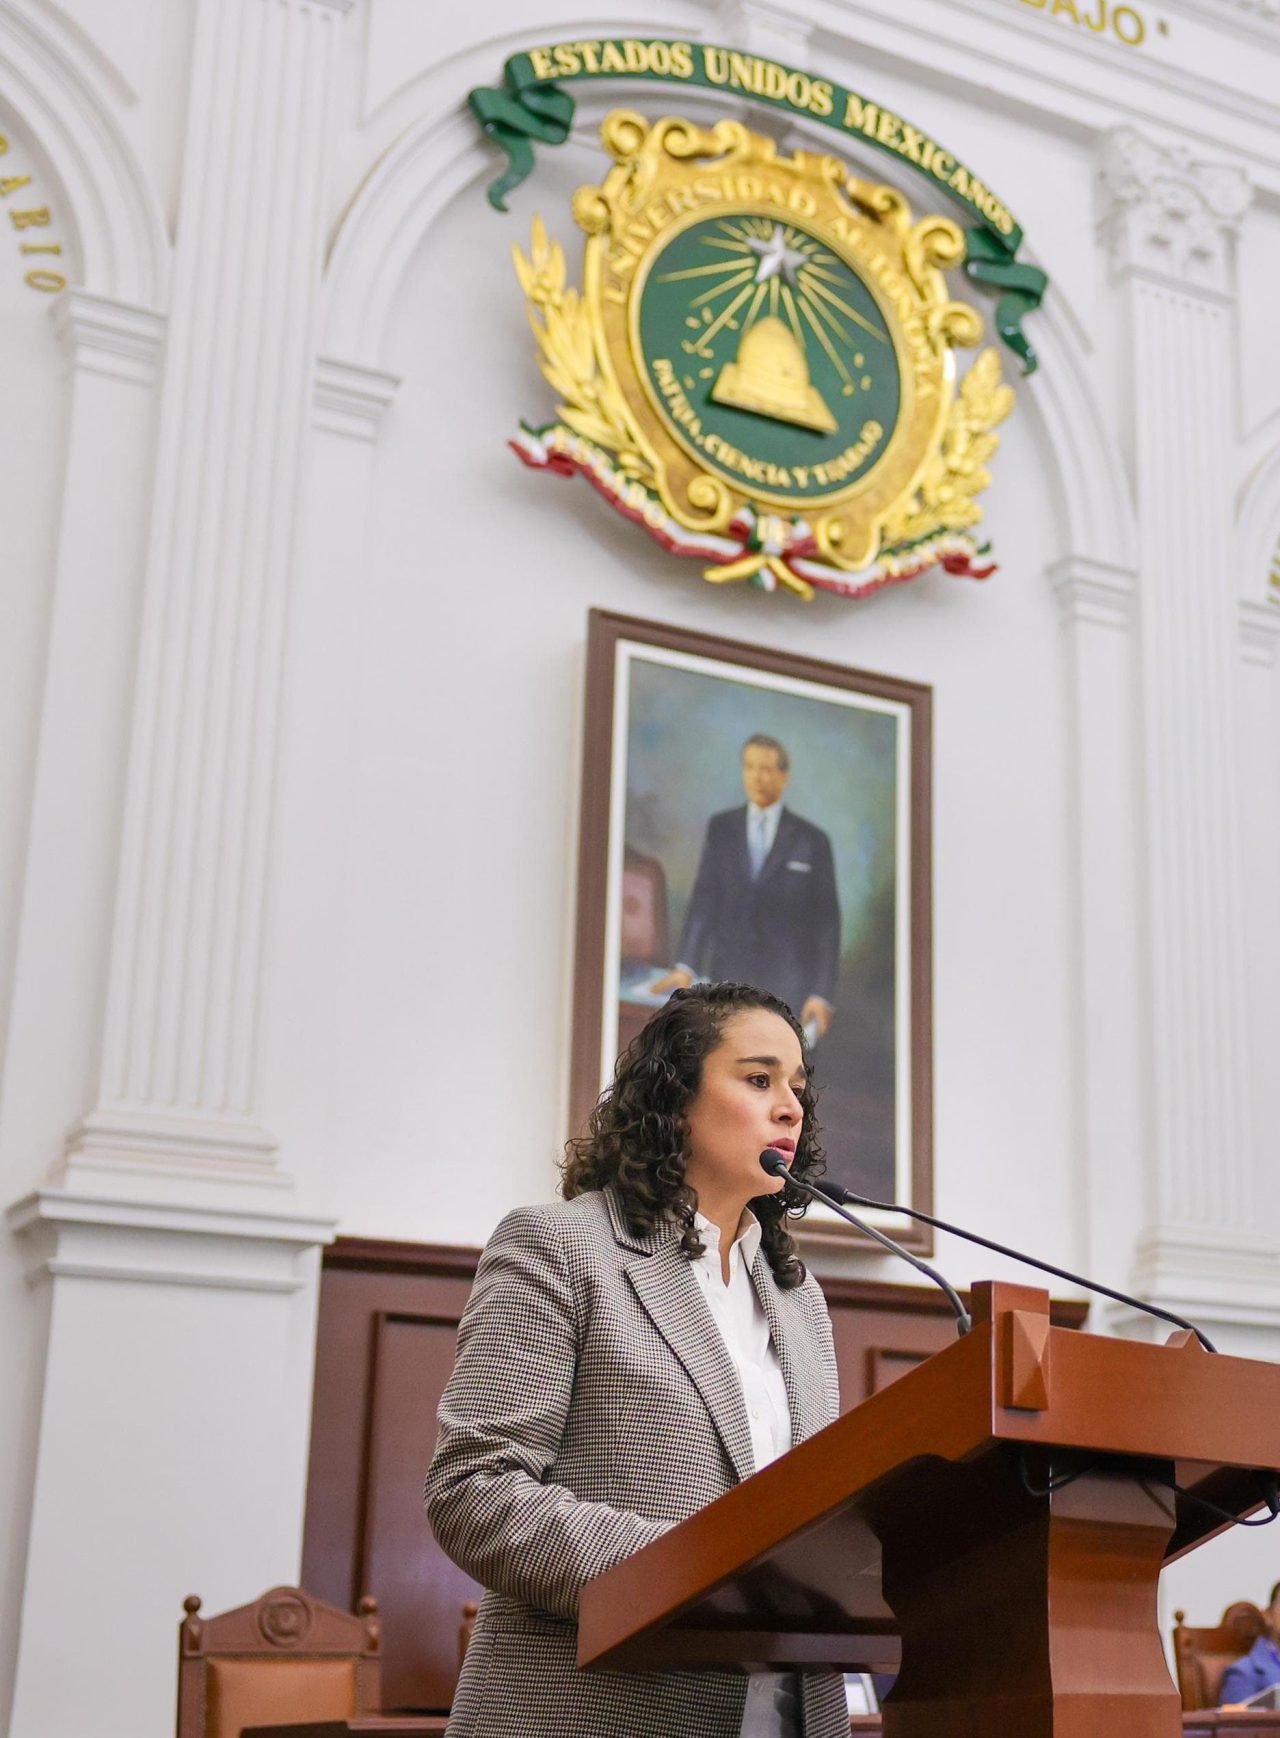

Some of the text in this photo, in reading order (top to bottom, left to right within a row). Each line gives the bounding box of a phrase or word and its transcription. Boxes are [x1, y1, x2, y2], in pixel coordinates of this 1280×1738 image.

[529, 40, 1016, 236] ESTADOS UNIDOS MEXICANOS
